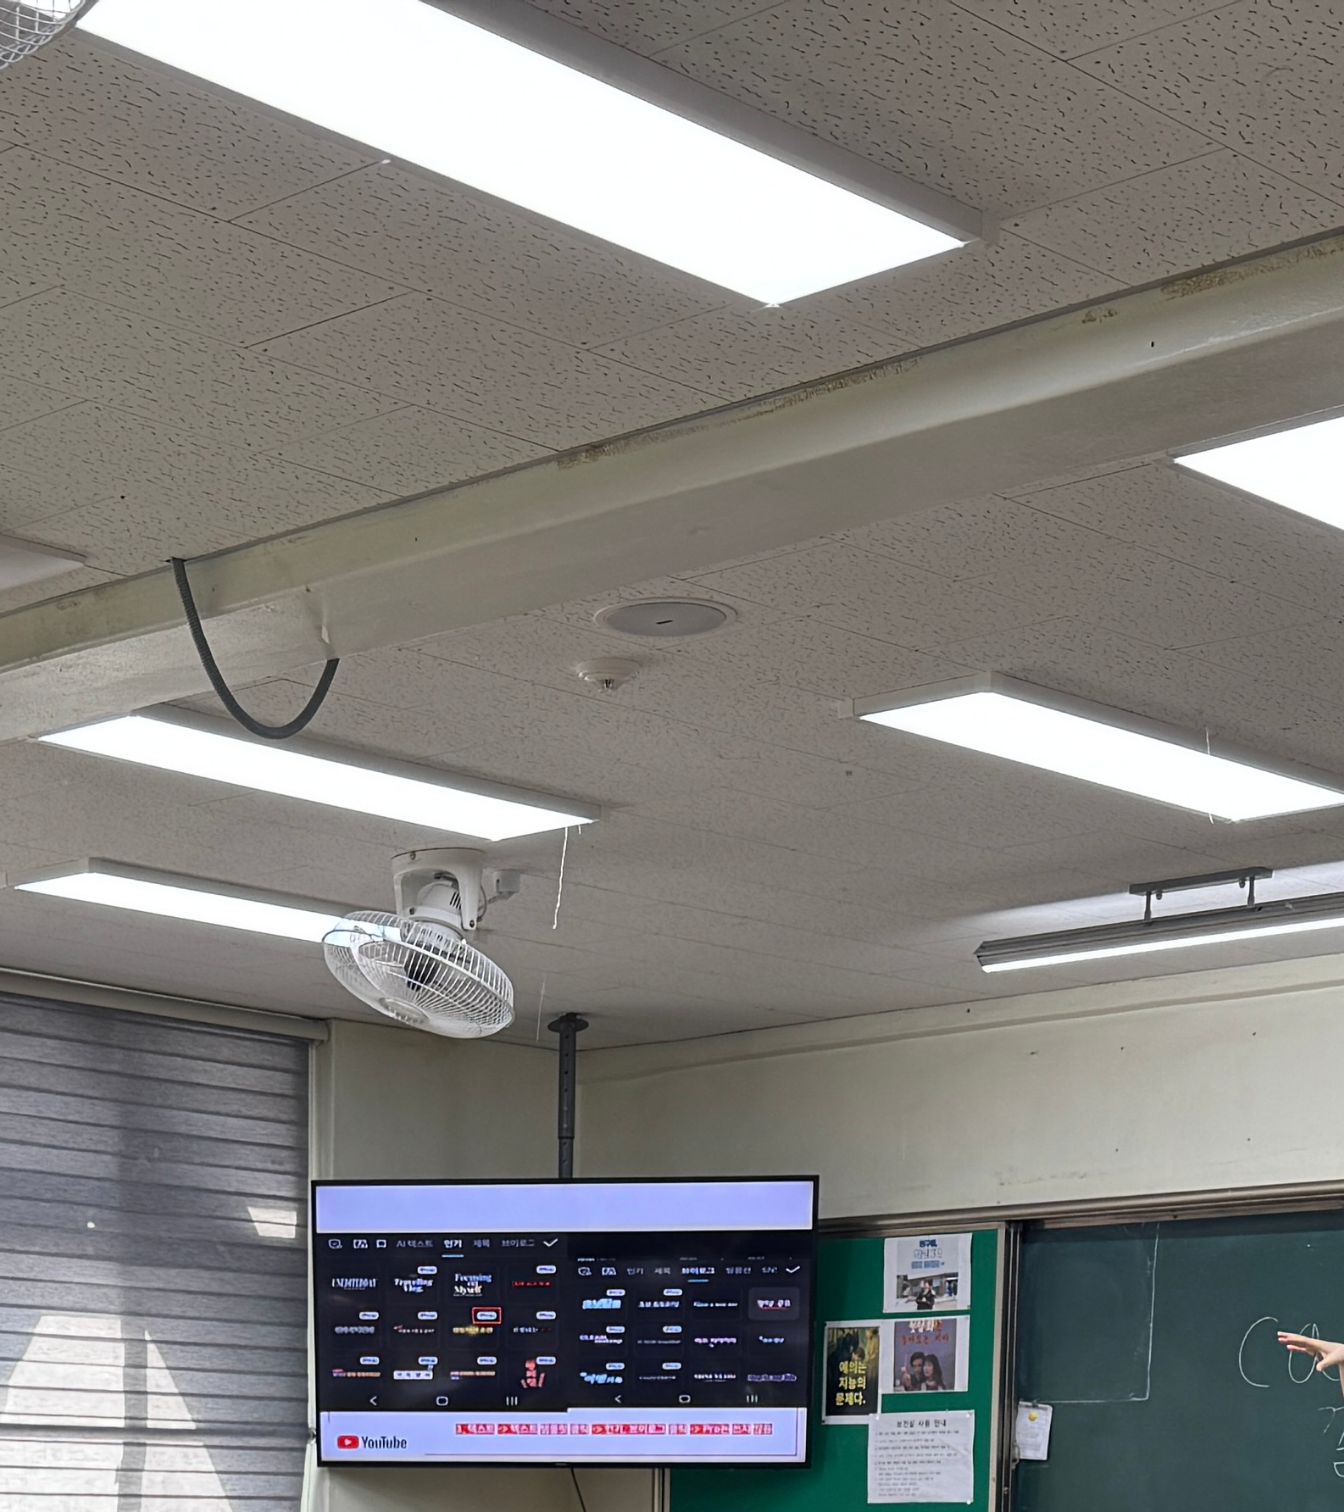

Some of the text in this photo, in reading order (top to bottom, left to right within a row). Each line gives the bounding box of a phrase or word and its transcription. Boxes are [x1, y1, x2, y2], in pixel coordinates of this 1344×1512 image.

[839, 1361, 867, 1374] 예의는
[839, 1376, 866, 1390] 지능의
[836, 1392, 866, 1406] 문제다.
[361, 1436, 407, 1449] YouTube
